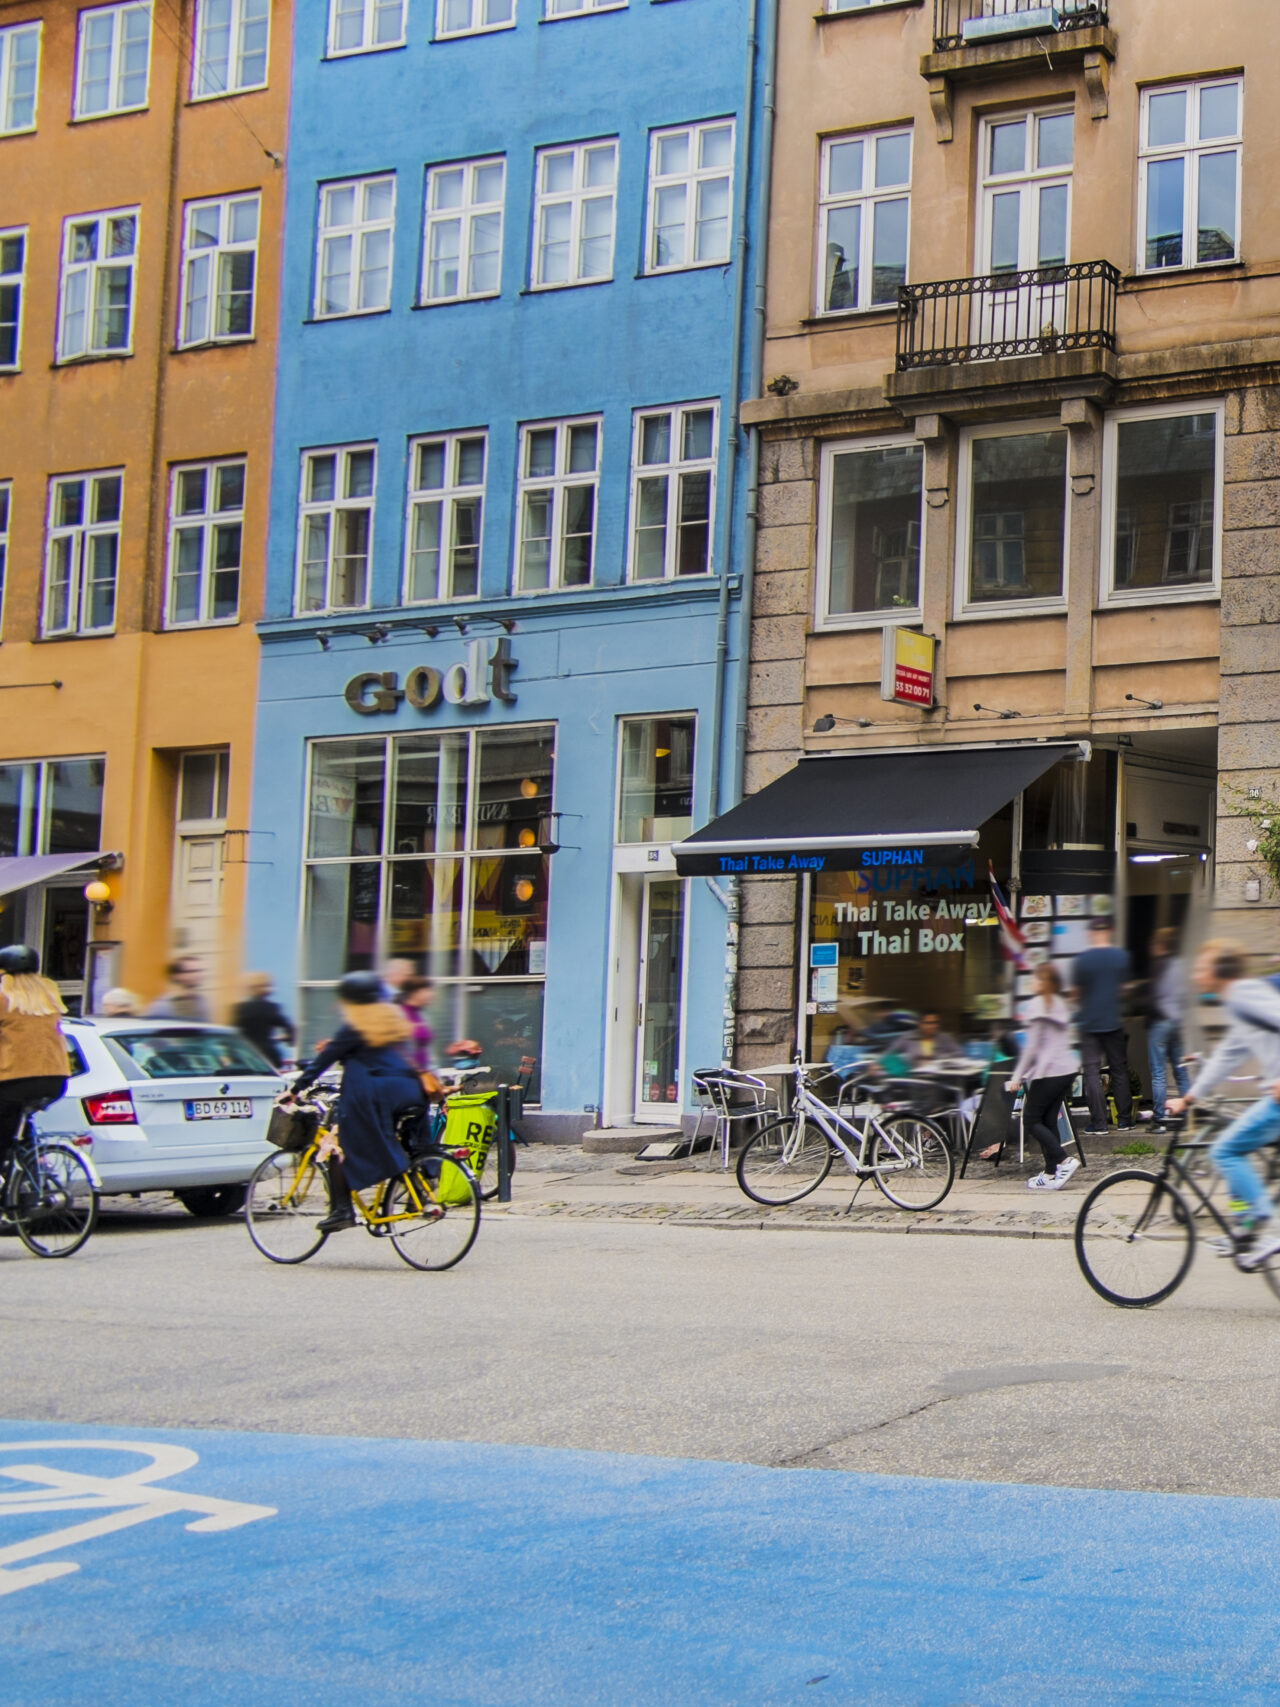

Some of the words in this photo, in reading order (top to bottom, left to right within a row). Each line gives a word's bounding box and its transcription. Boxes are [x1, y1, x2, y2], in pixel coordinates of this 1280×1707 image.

[896, 681, 903, 692] 33
[914, 686, 922, 696] 00
[923, 688, 930, 698] 71
[719, 856, 748, 871] Thai
[751, 855, 785, 870] Take
[788, 854, 826, 872] Away
[861, 849, 924, 866] SUPHAN
[856, 860, 975, 893] SUPHAN
[834, 900, 878, 923] Thai
[883, 901, 930, 922] Take
[935, 899, 993, 924] Away
[857, 928, 910, 955] Thai
[918, 929, 965, 953] Box
[195, 1103, 211, 1114] BD
[214, 1103, 228, 1113] 69
[231, 1102, 250, 1113] 116
